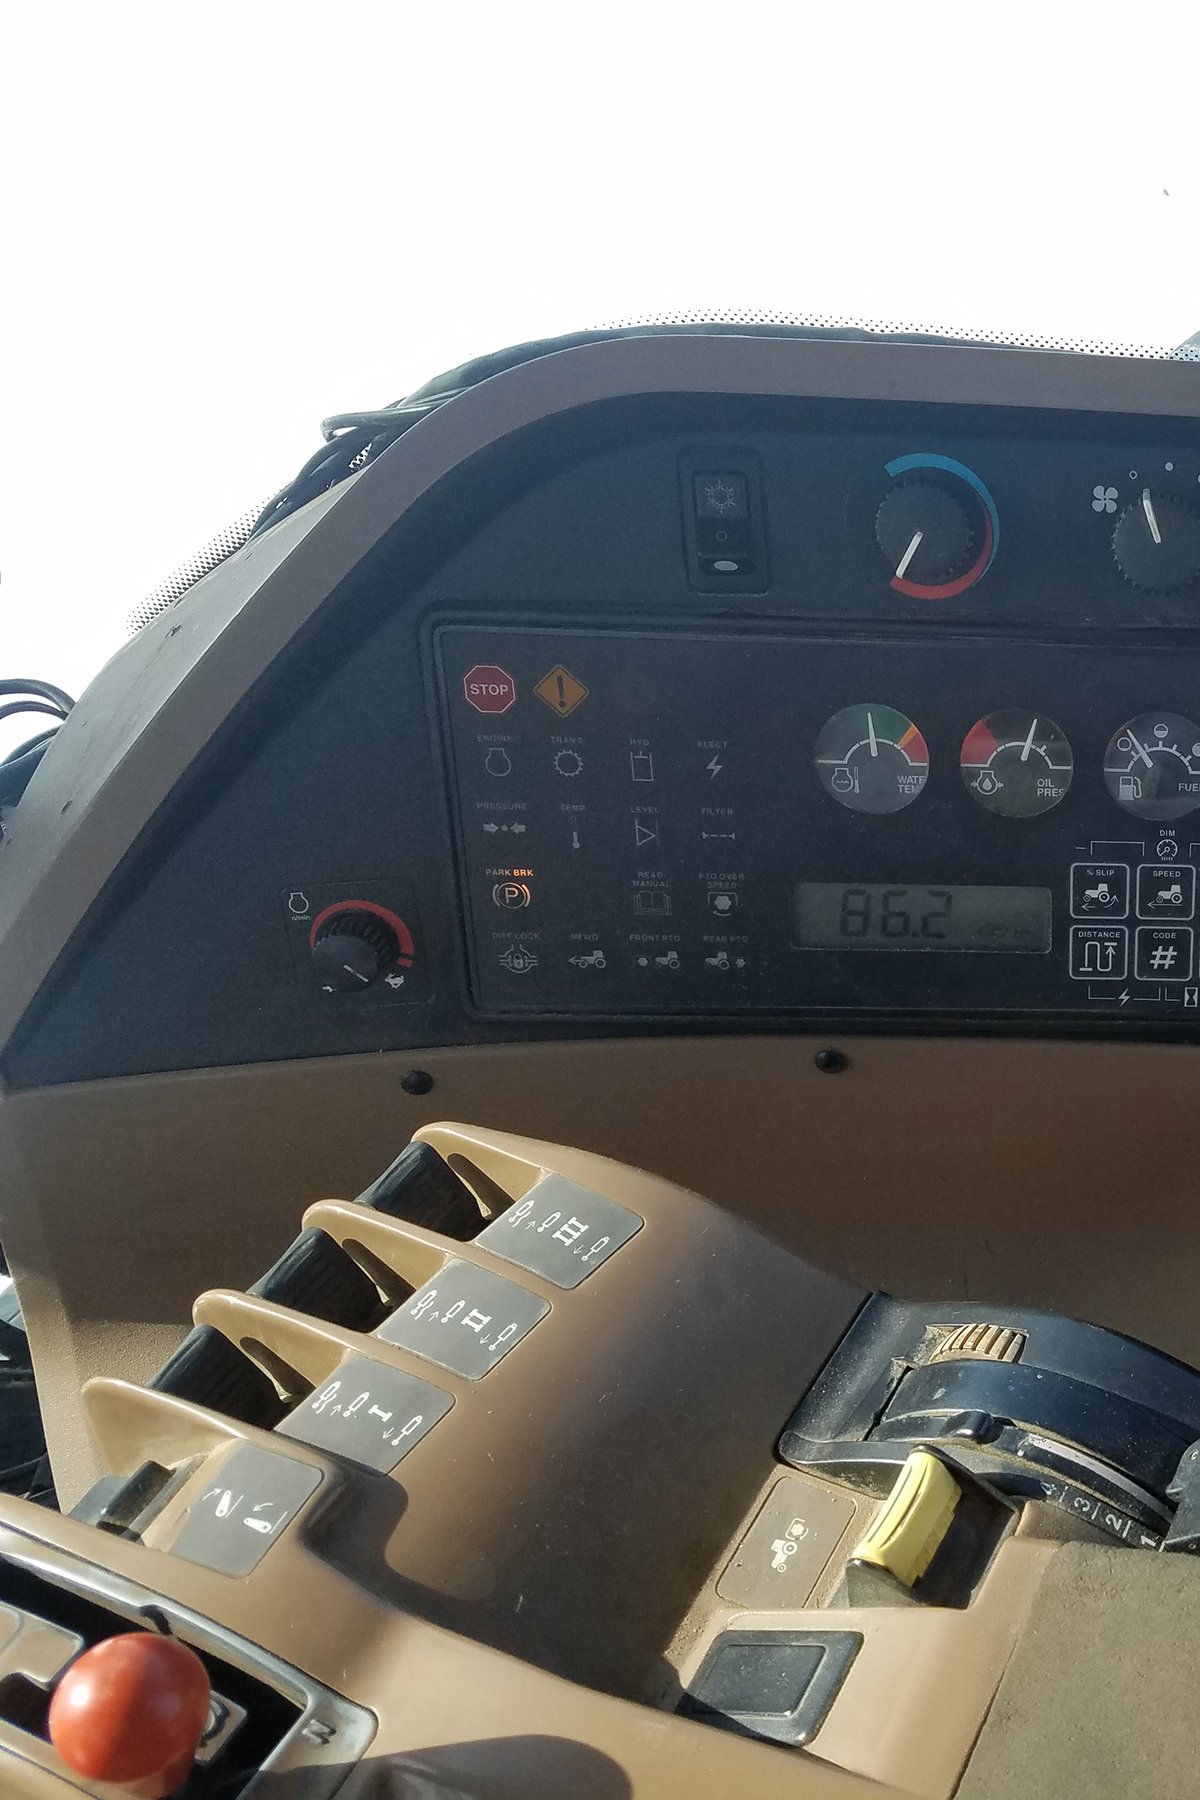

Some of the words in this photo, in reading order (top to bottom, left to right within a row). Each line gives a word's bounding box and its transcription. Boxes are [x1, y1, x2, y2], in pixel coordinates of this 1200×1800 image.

[470, 684, 509, 696] STOP
[697, 741, 729, 749] ELECT
[1037, 779, 1055, 788] OIL
[477, 803, 527, 811] PRESSURE
[560, 804, 586, 812] TEMP
[630, 806, 660, 814] LEVEL
[701, 808, 734, 816] FILTER
[485, 868, 511, 876] PARK
[513, 868, 534, 877] BRK
[1152, 870, 1181, 878] SPEED
[632, 881, 671, 889] MANUAL
[707, 881, 738, 889] SPEED
[841, 889, 952, 939] 86.2
[552, 1216, 590, 1247] III
[461, 1308, 491, 1333] II
[1074, 1497, 1091, 1512] 3
[1105, 1513, 1123, 1531] 2
[1140, 1534, 1156, 1548] 1
